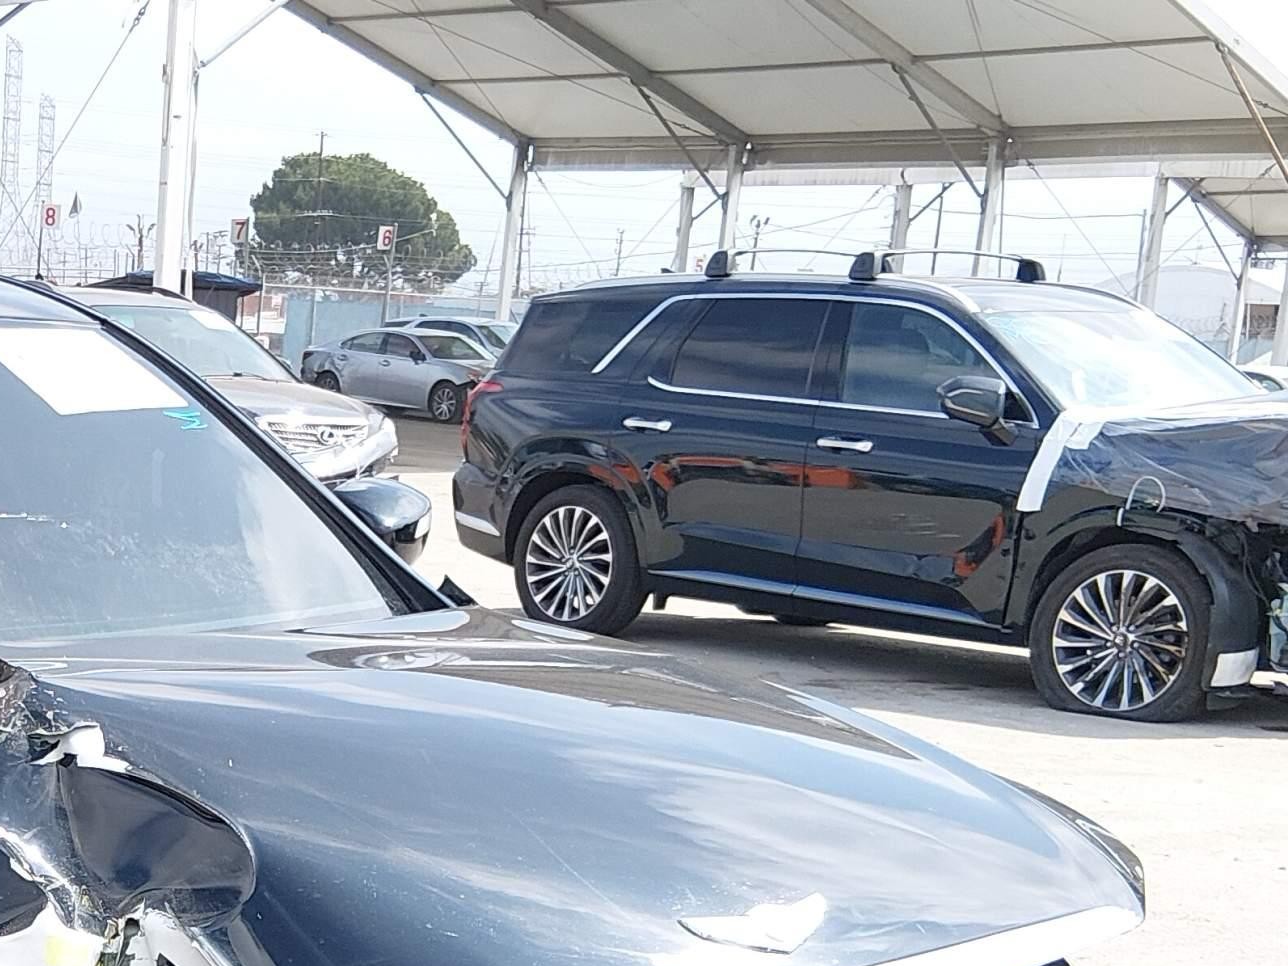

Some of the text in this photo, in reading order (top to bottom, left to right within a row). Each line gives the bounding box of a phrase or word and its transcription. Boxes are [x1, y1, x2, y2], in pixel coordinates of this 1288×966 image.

[44, 207, 56, 226] 8
[235, 221, 247, 240] 7
[382, 229, 393, 246] 6
[695, 258, 704, 273] 5
